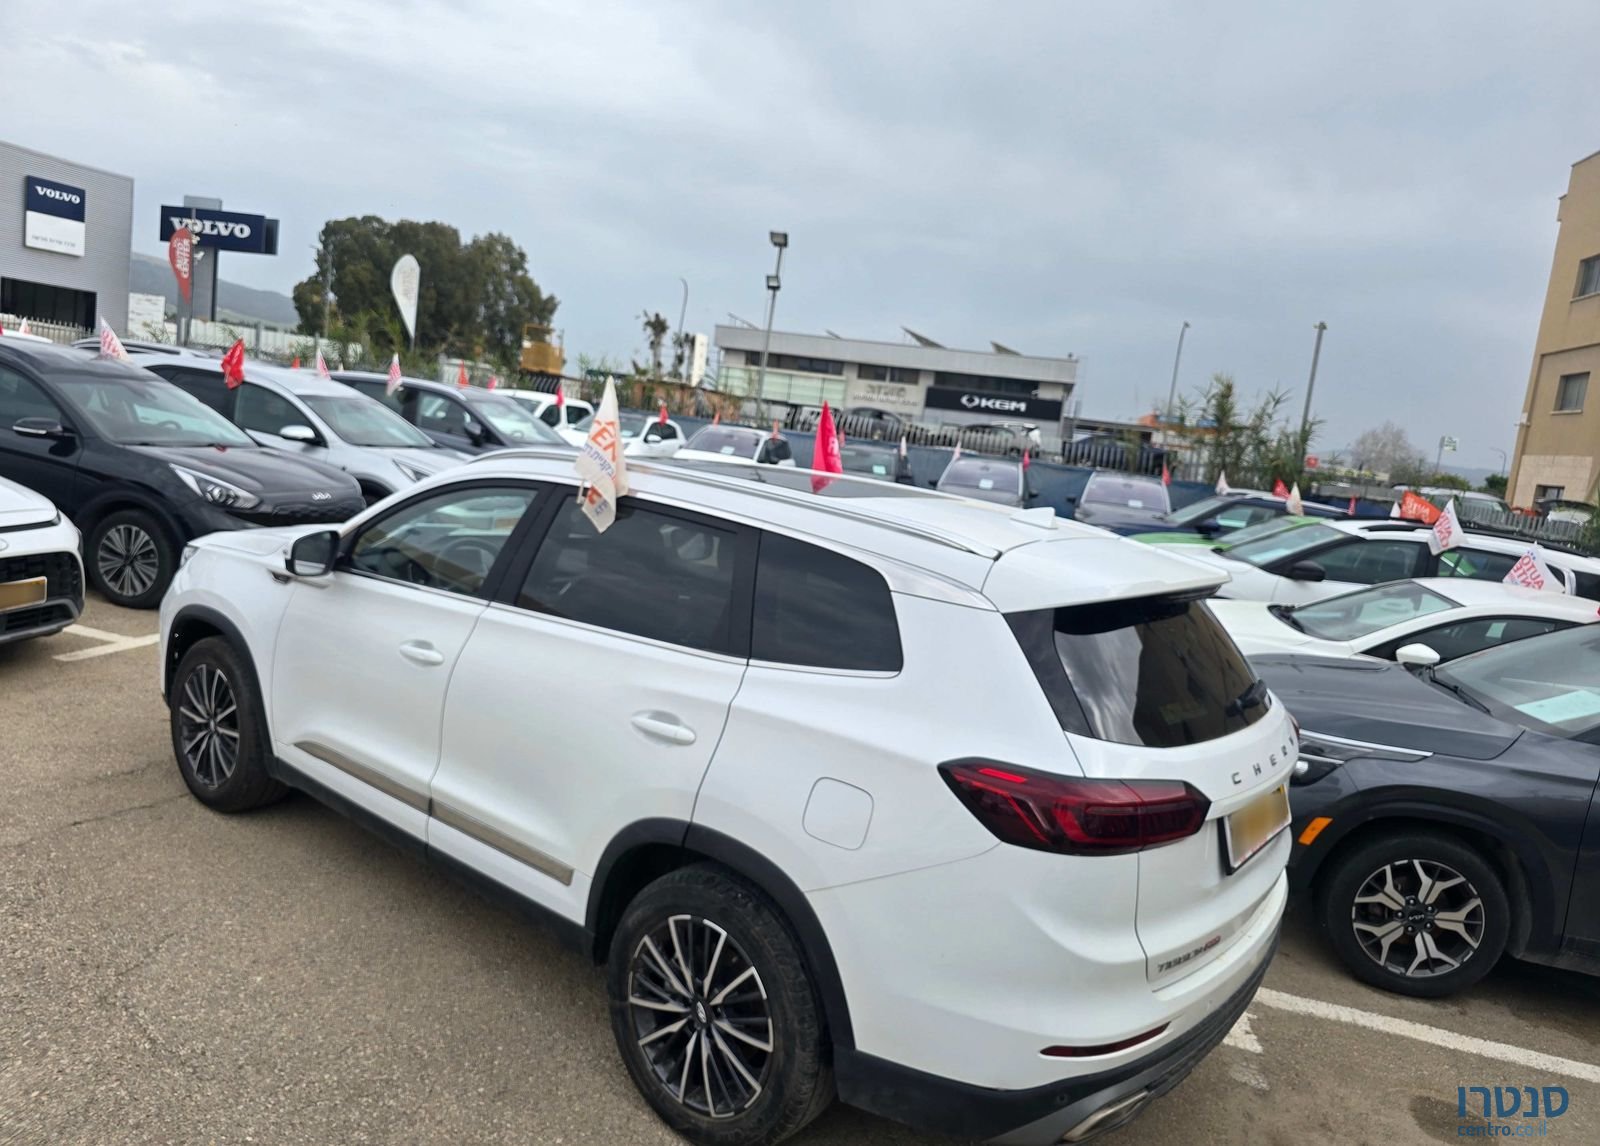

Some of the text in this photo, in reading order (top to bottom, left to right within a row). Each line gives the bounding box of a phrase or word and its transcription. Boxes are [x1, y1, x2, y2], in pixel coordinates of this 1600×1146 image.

[35, 185, 81, 205] VOLVO
[169, 216, 251, 239] VOLVO
[980, 397, 1027, 413] KGM
